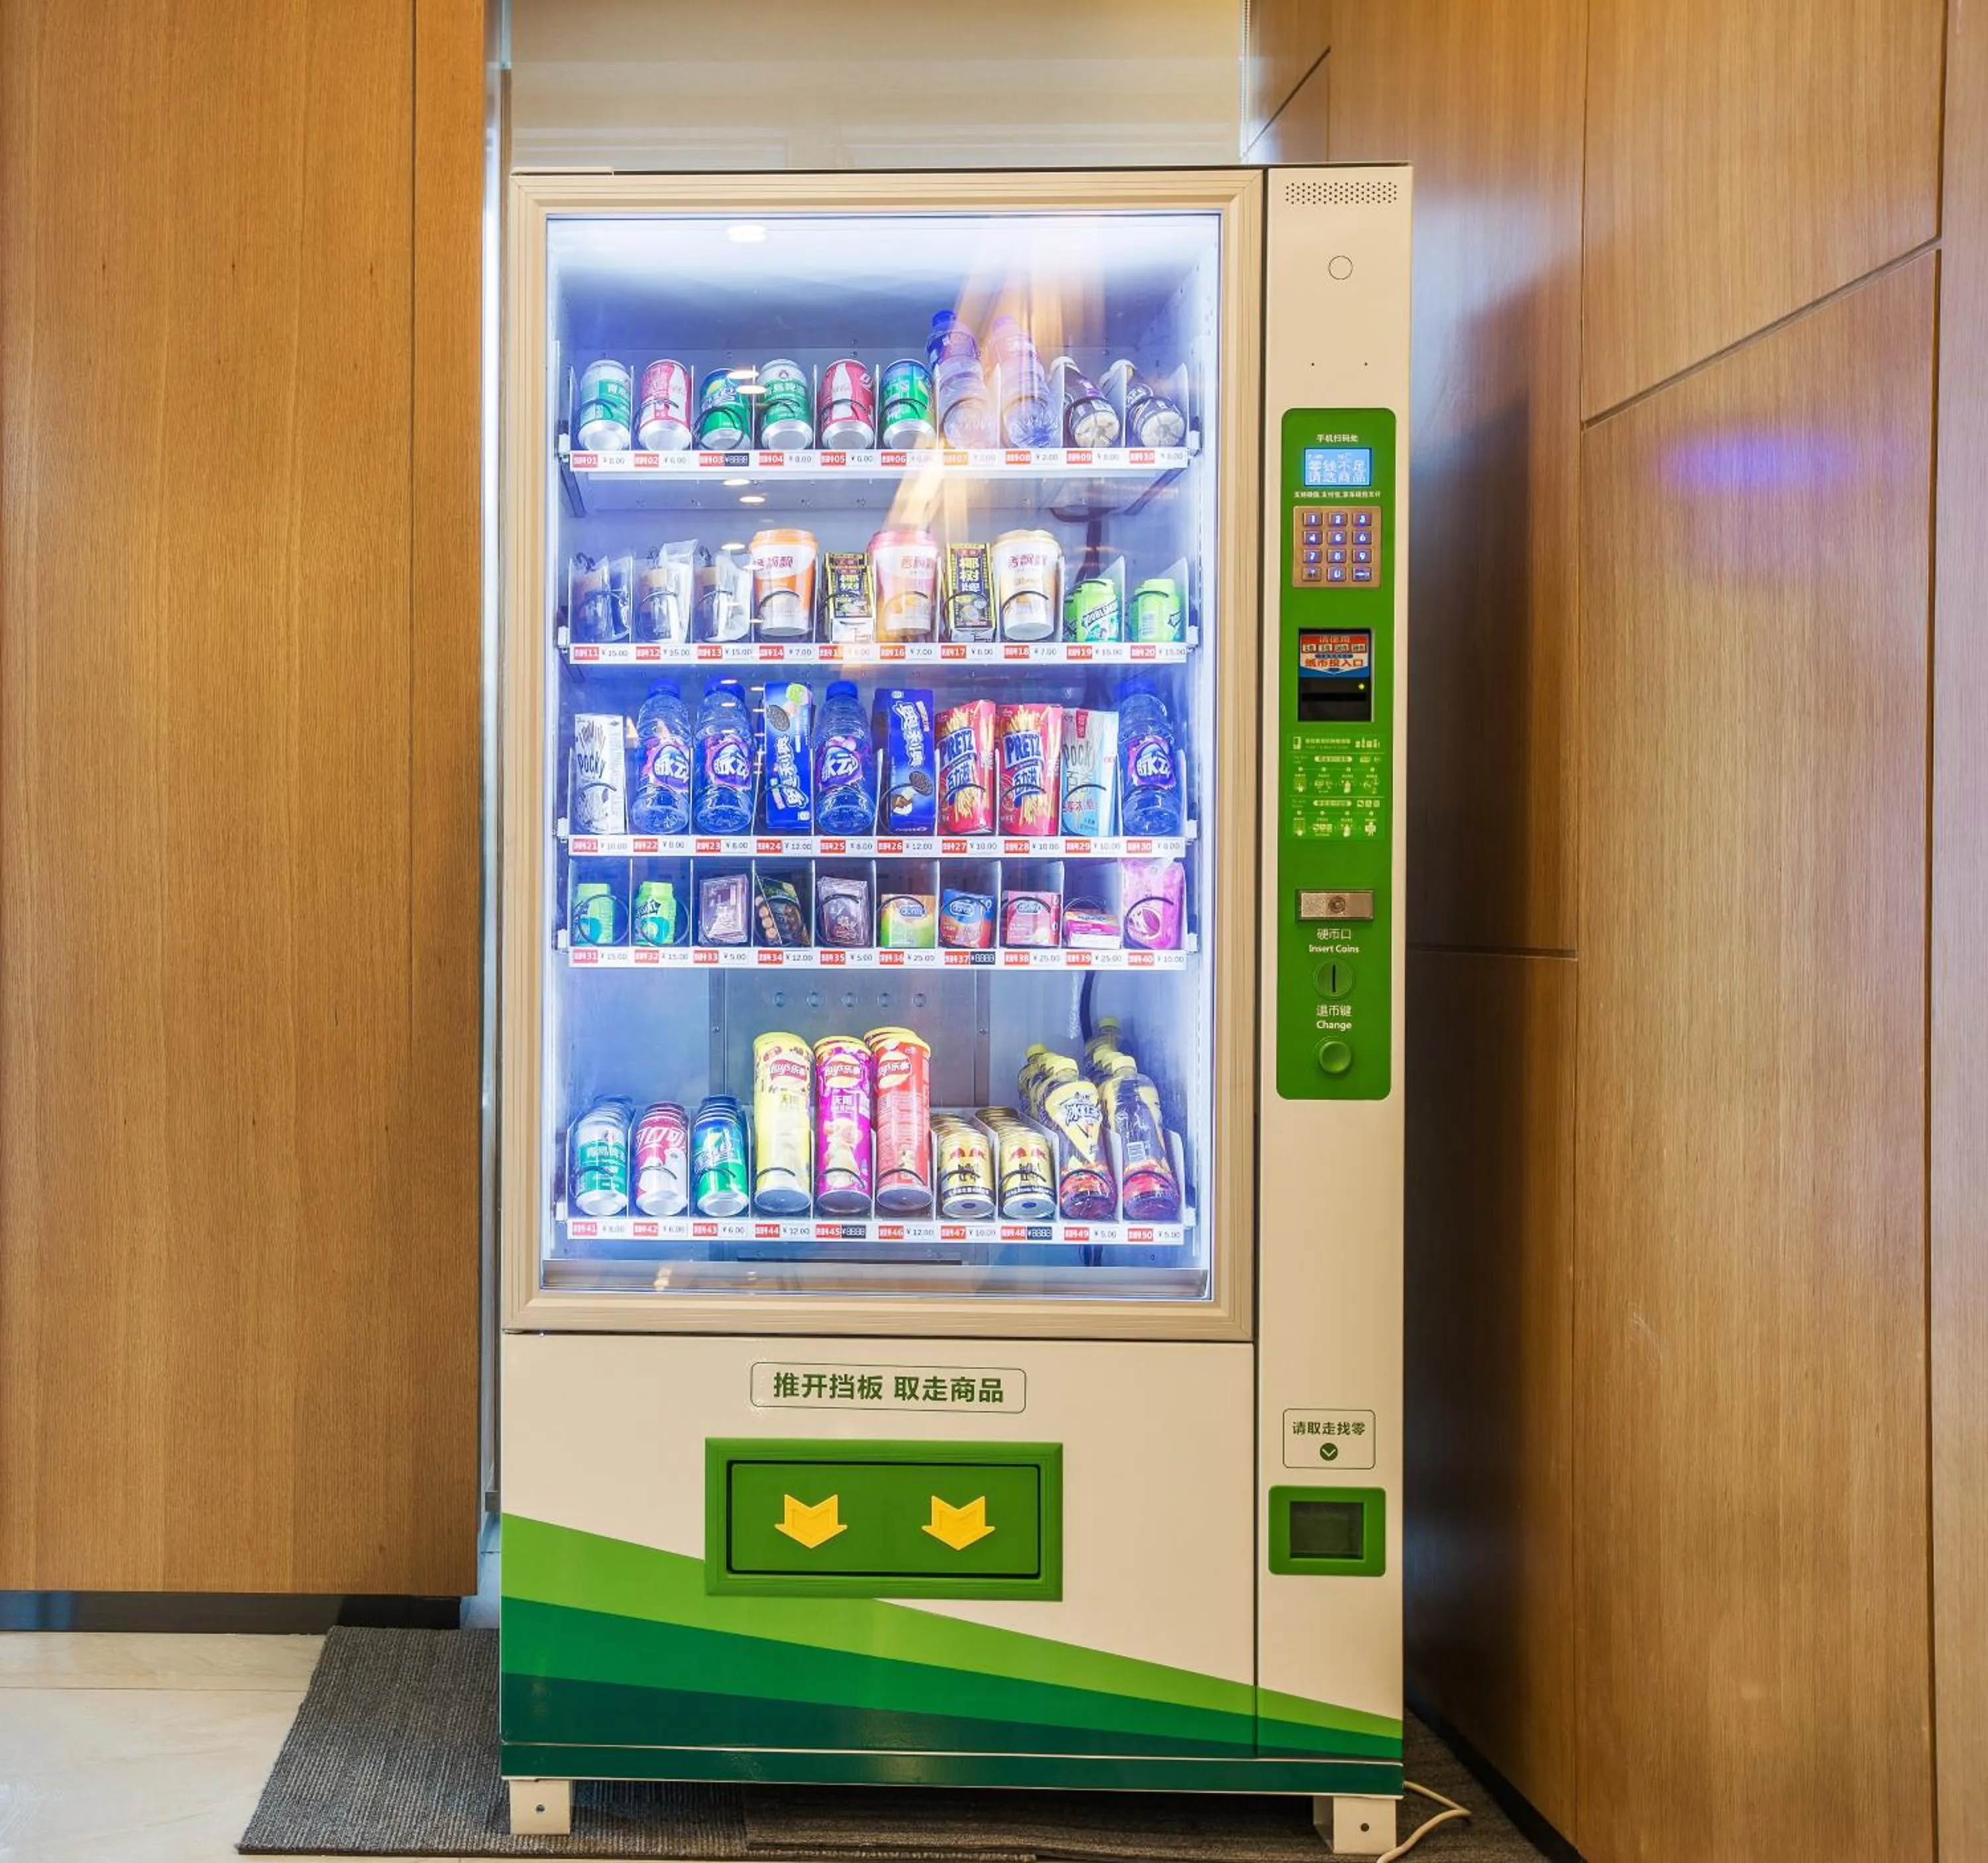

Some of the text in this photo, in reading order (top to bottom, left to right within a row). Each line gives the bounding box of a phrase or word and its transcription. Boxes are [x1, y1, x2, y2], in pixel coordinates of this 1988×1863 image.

[1317, 434, 1358, 443] 手机扫码处
[1335, 515, 1341, 523] 2
[1359, 515, 1365, 523] 3
[1309, 533, 1315, 542] 4
[1359, 551, 1366, 560] 9
[1005, 733, 1041, 765] PRETZ
[1317, 928, 1351, 939] 硬币口
[1309, 944, 1359, 953] Insert Coins
[1317, 1005, 1352, 1016] 退币键
[1317, 1020, 1352, 1032] Change
[773, 1372, 1003, 1403] 推开挡板 取走商品
[1292, 1421, 1366, 1436] 请取走找零
